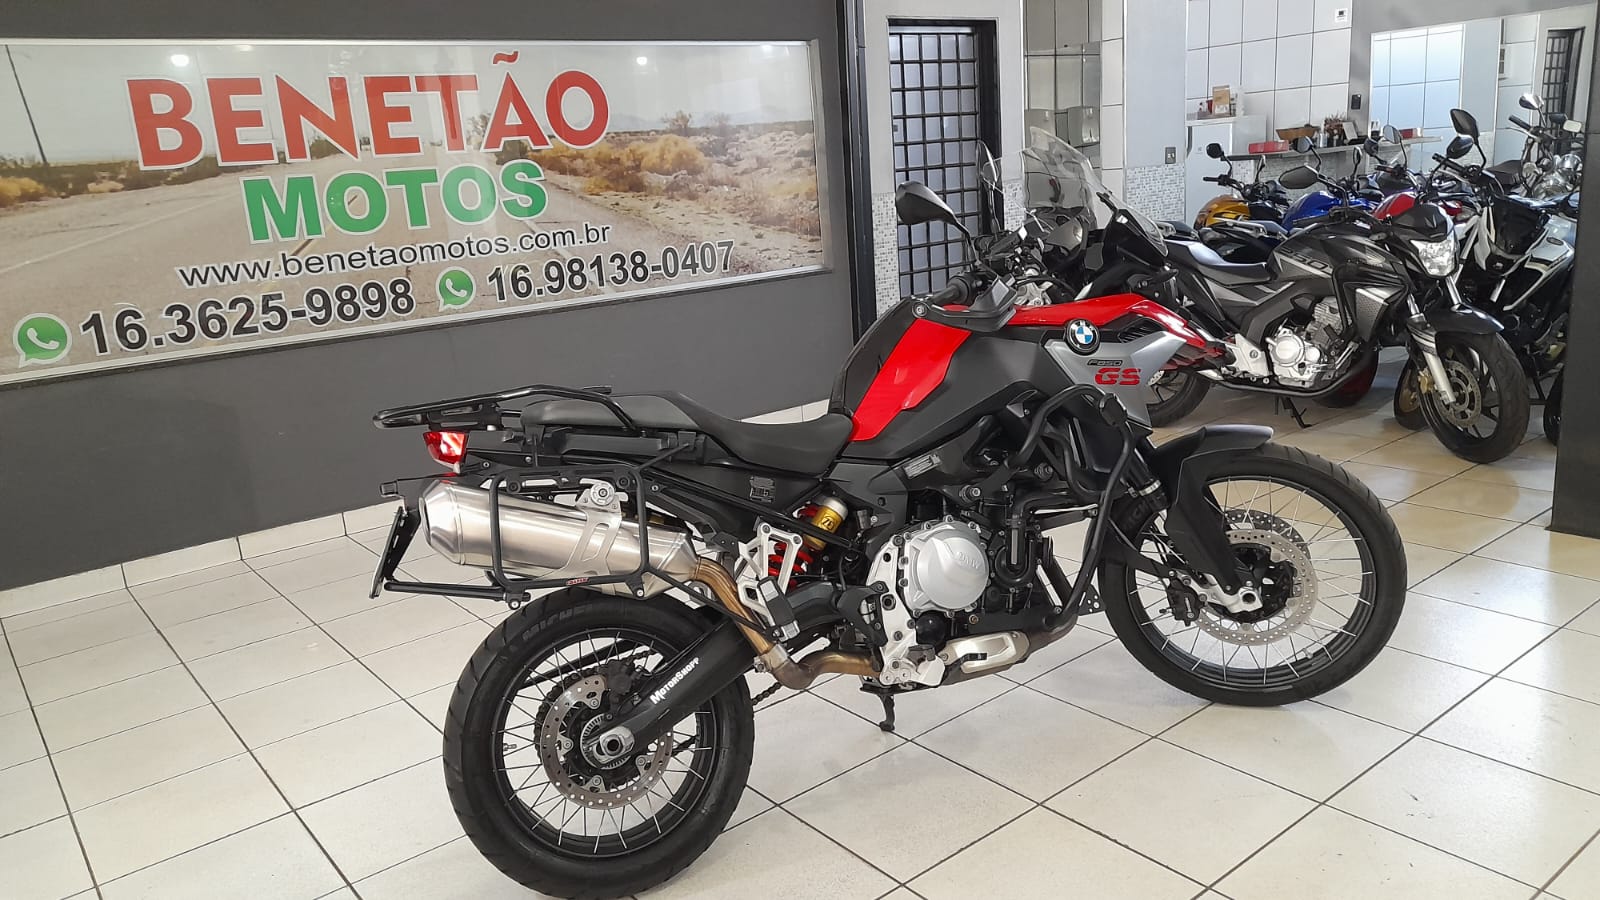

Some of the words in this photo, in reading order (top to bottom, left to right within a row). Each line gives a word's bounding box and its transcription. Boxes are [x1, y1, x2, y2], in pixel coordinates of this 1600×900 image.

[127, 51, 609, 167] BENETÃO
[243, 161, 547, 241] MOTOS
[179, 223, 611, 286] www.benetaomotos.com.br
[488, 240, 735, 301] 16.98138-0407
[81, 278, 415, 354] 16.3625-9898
[1095, 367, 1141, 385] GS
